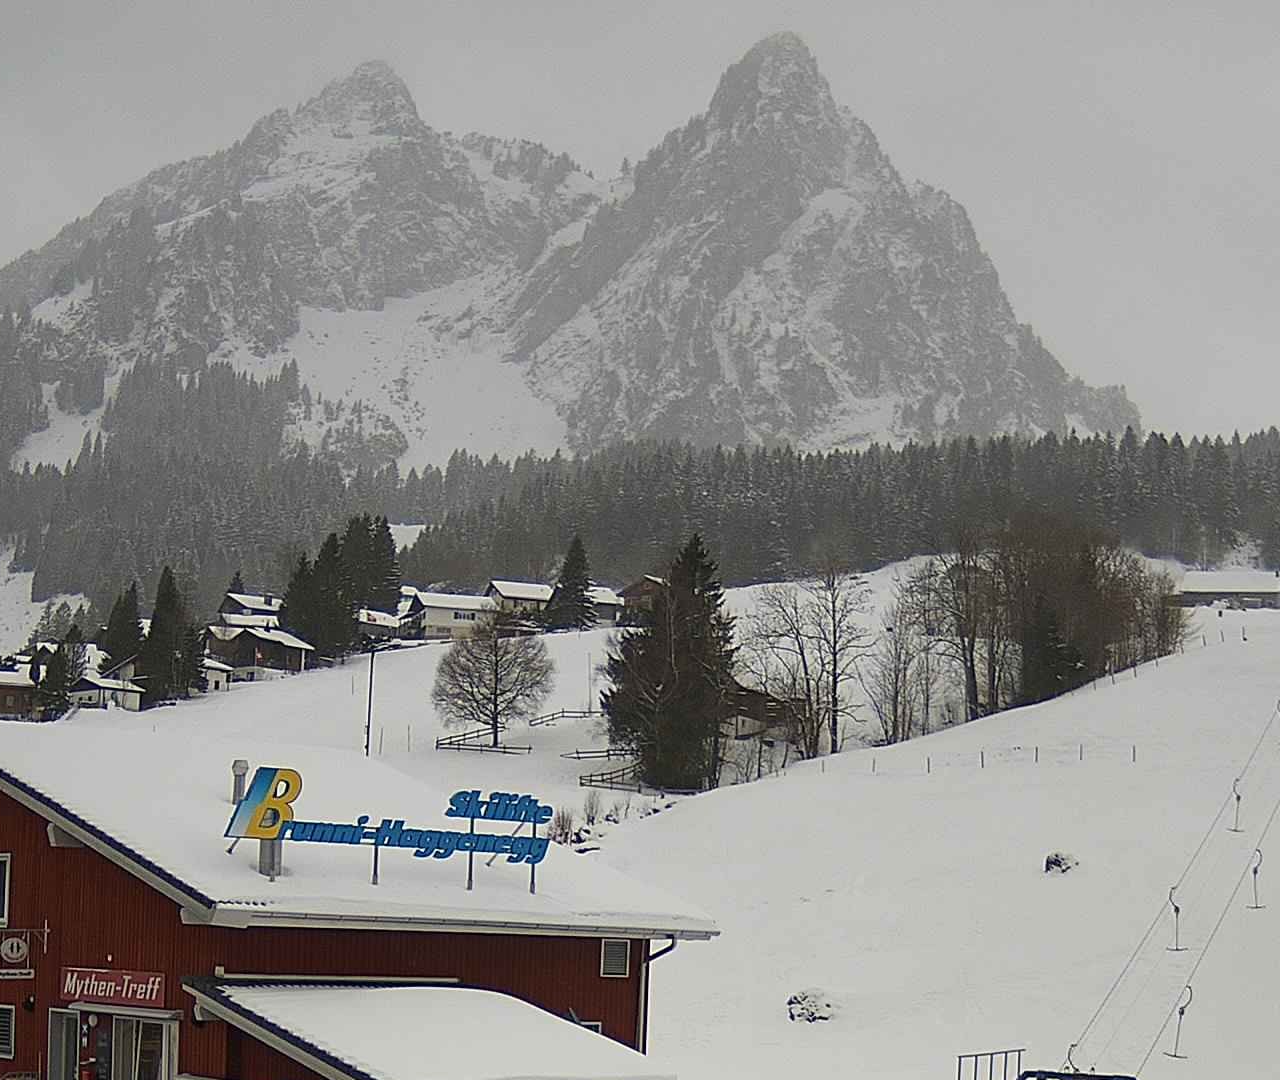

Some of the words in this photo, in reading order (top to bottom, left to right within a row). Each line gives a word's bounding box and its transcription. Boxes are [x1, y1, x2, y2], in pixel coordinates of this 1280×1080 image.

[224, 766, 551, 864] Brunni-Haggenegg
[445, 790, 553, 824] Skilifte
[63, 972, 162, 1001] Mythen-Treff
